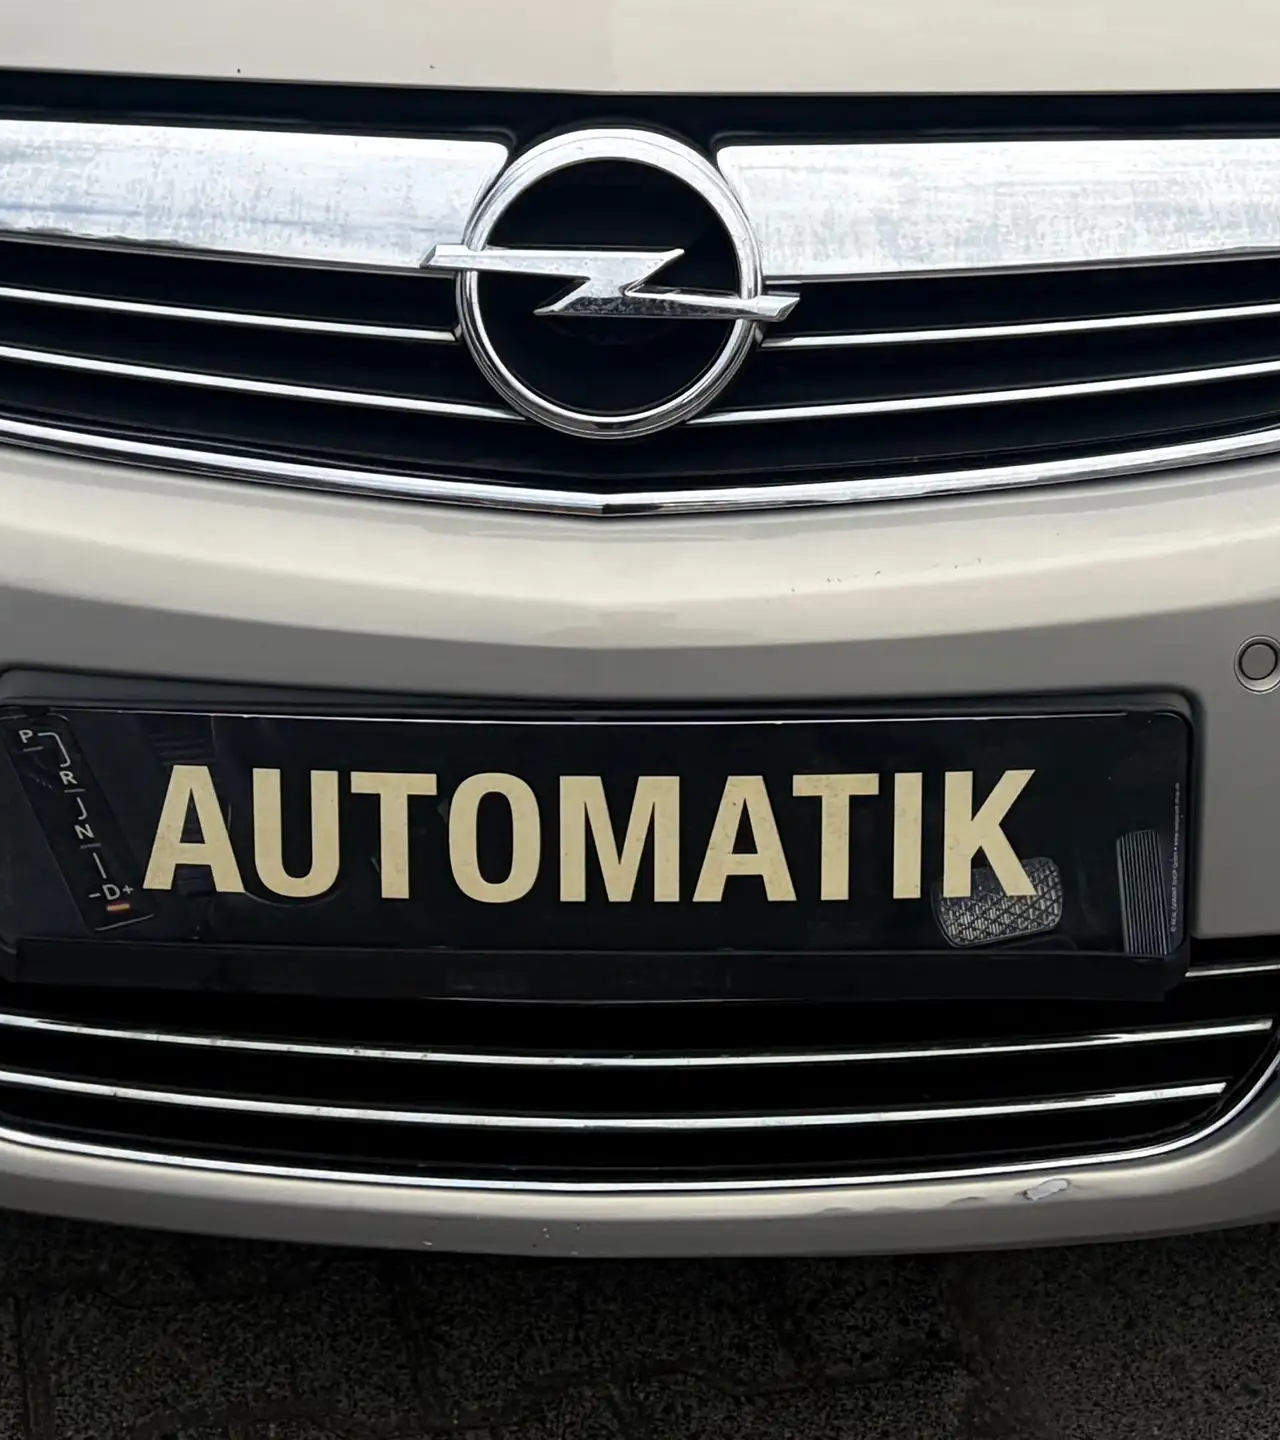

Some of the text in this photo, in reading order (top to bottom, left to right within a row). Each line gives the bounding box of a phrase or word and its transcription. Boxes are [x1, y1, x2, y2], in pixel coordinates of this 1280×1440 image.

[18, 728, 34, 744] P
[59, 770, 78, 786] R
[74, 823, 95, 840] N
[143, 764, 1036, 904] AUTOMATIK
